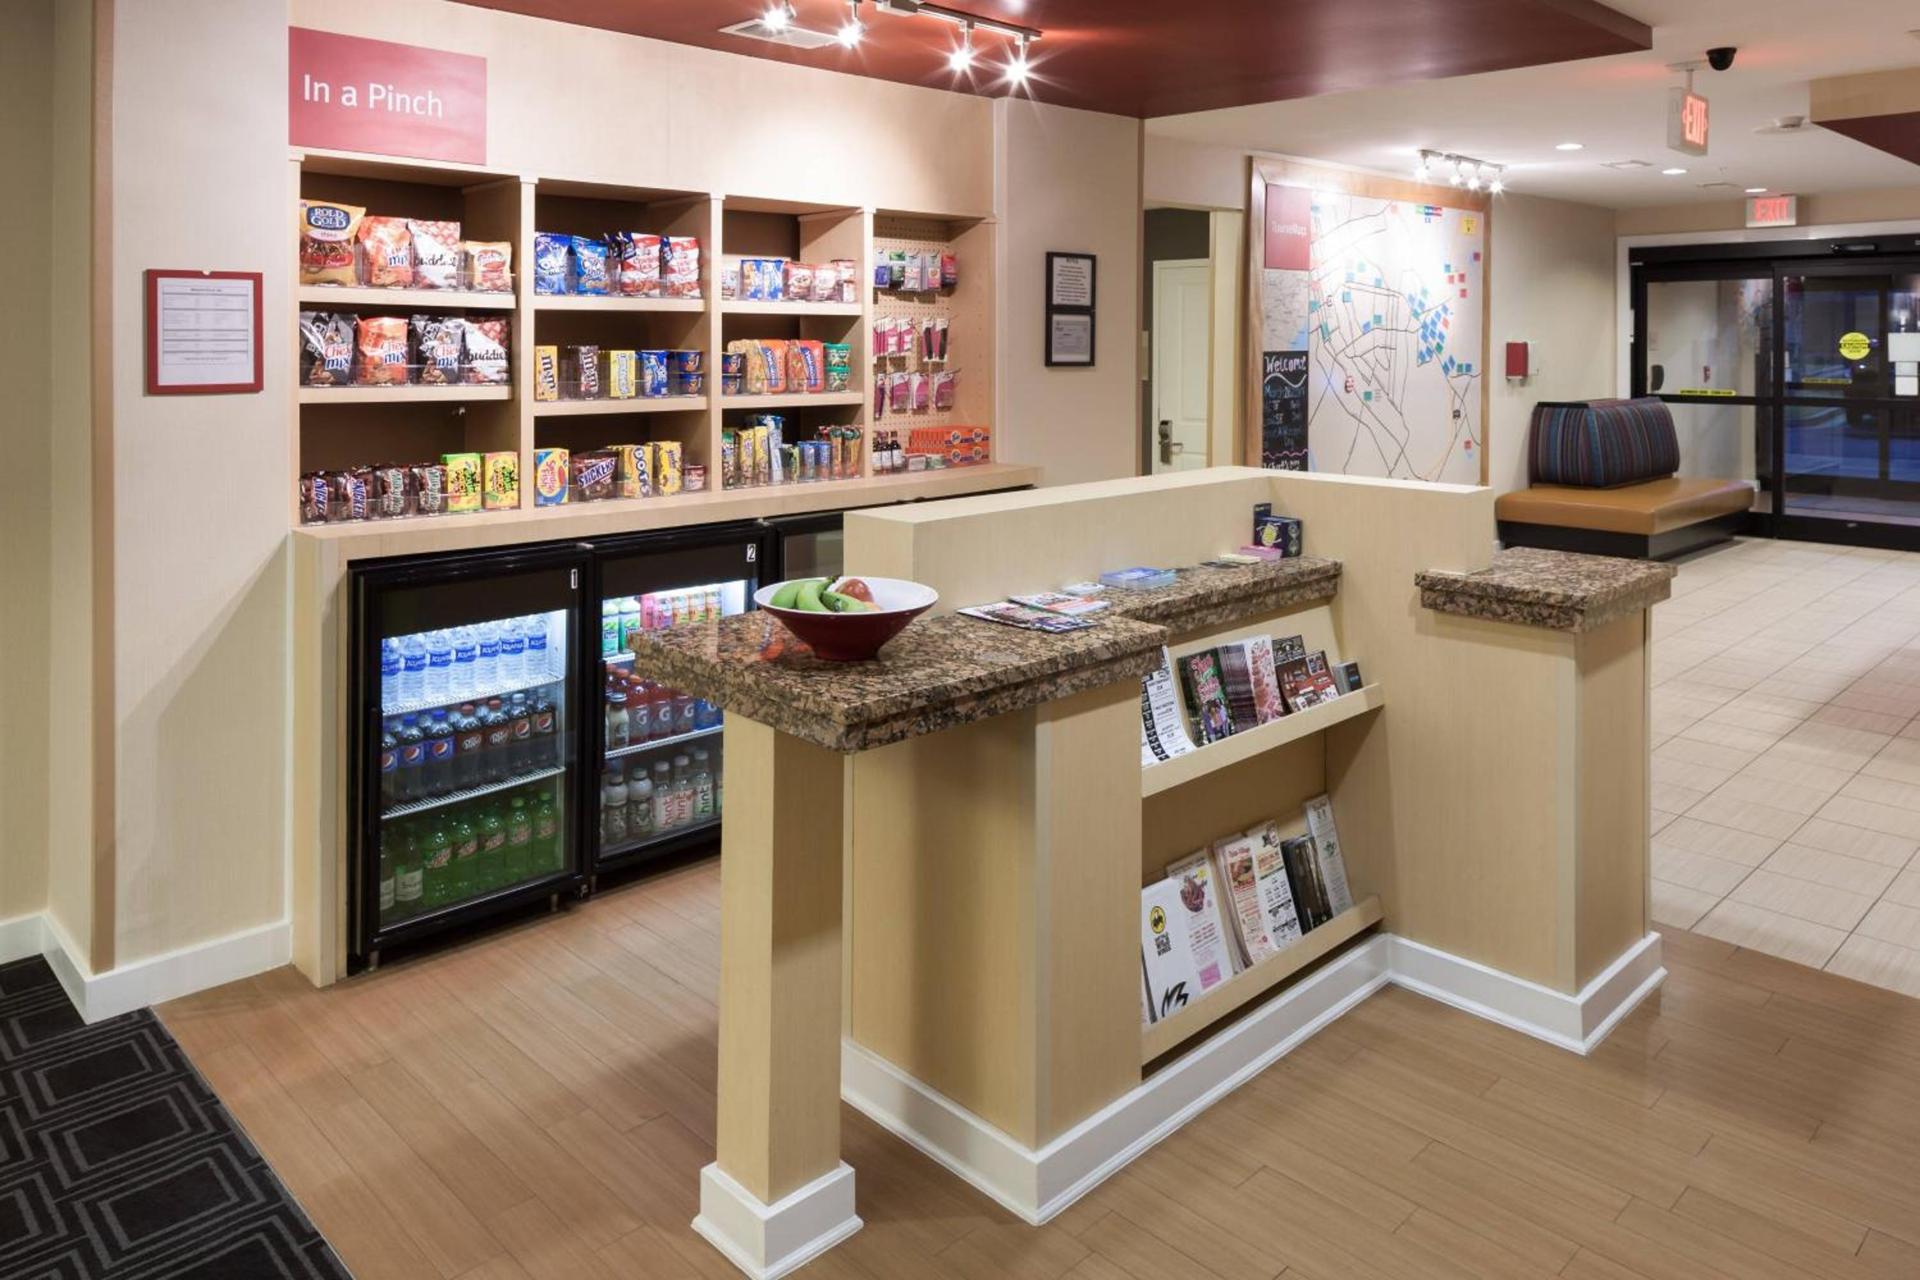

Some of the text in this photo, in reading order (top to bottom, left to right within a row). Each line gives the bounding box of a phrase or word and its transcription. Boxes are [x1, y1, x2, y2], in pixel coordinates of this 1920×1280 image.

[304, 74, 443, 118] In a Pinch
[310, 215, 347, 228] GOLD
[748, 546, 755, 561] 2
[572, 570, 577, 588] 1
[637, 709, 648, 725] G
[659, 706, 670, 721] G
[684, 702, 694, 718] G
